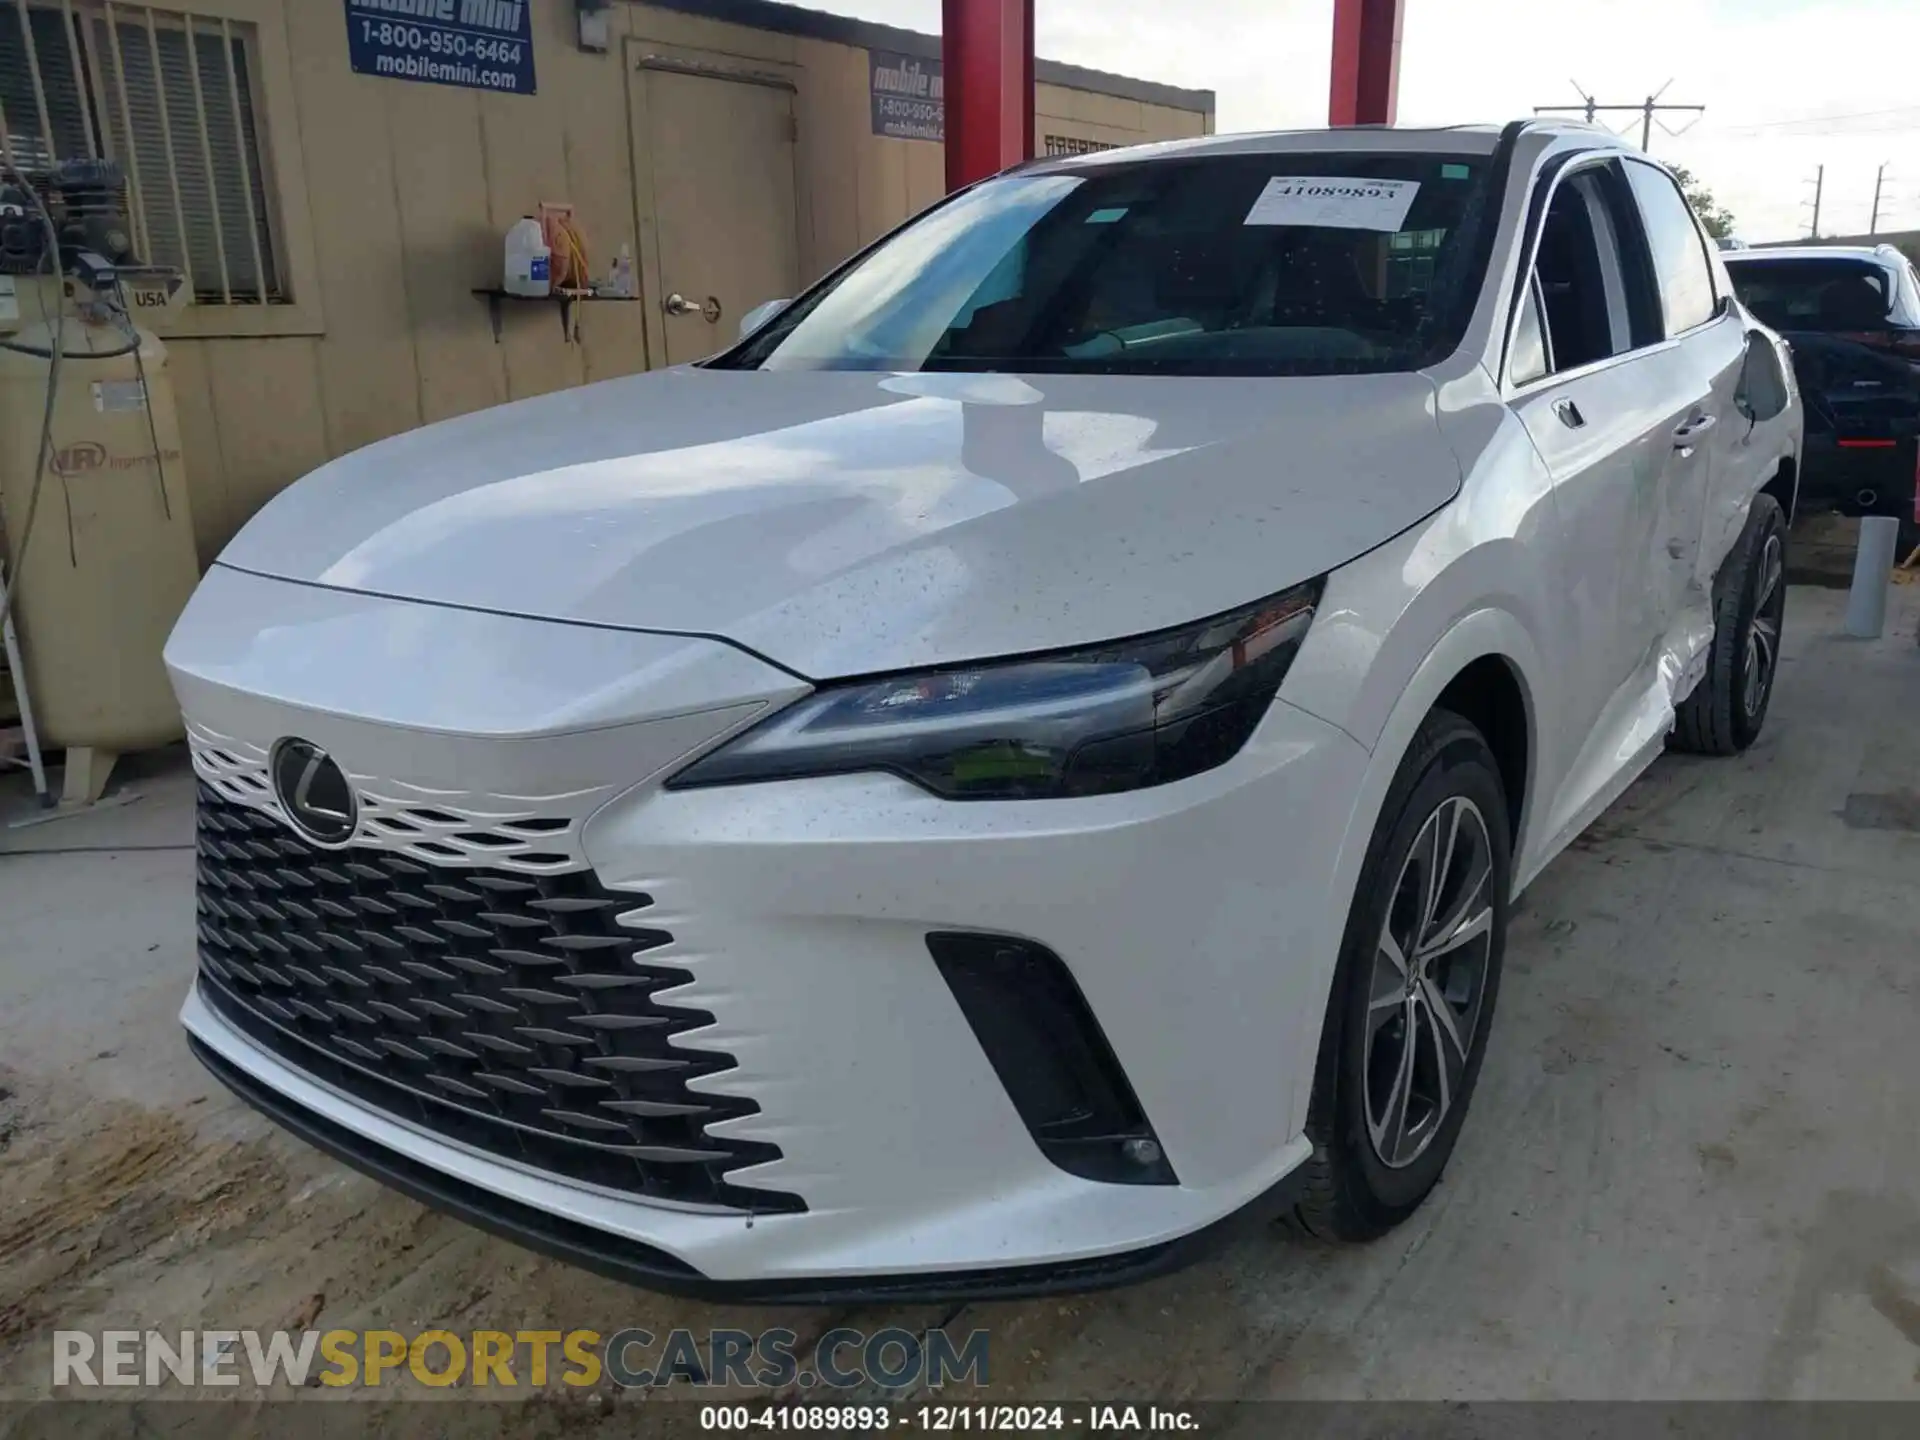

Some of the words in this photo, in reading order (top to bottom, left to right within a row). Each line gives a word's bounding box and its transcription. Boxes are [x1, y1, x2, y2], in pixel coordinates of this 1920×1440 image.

[362, 20, 521, 65] 1-800-950-6464
[376, 54, 516, 89] mobilemini.com
[874, 58, 927, 97] mobile
[1277, 185, 1395, 199] 41089893
[135, 291, 167, 307] USA
